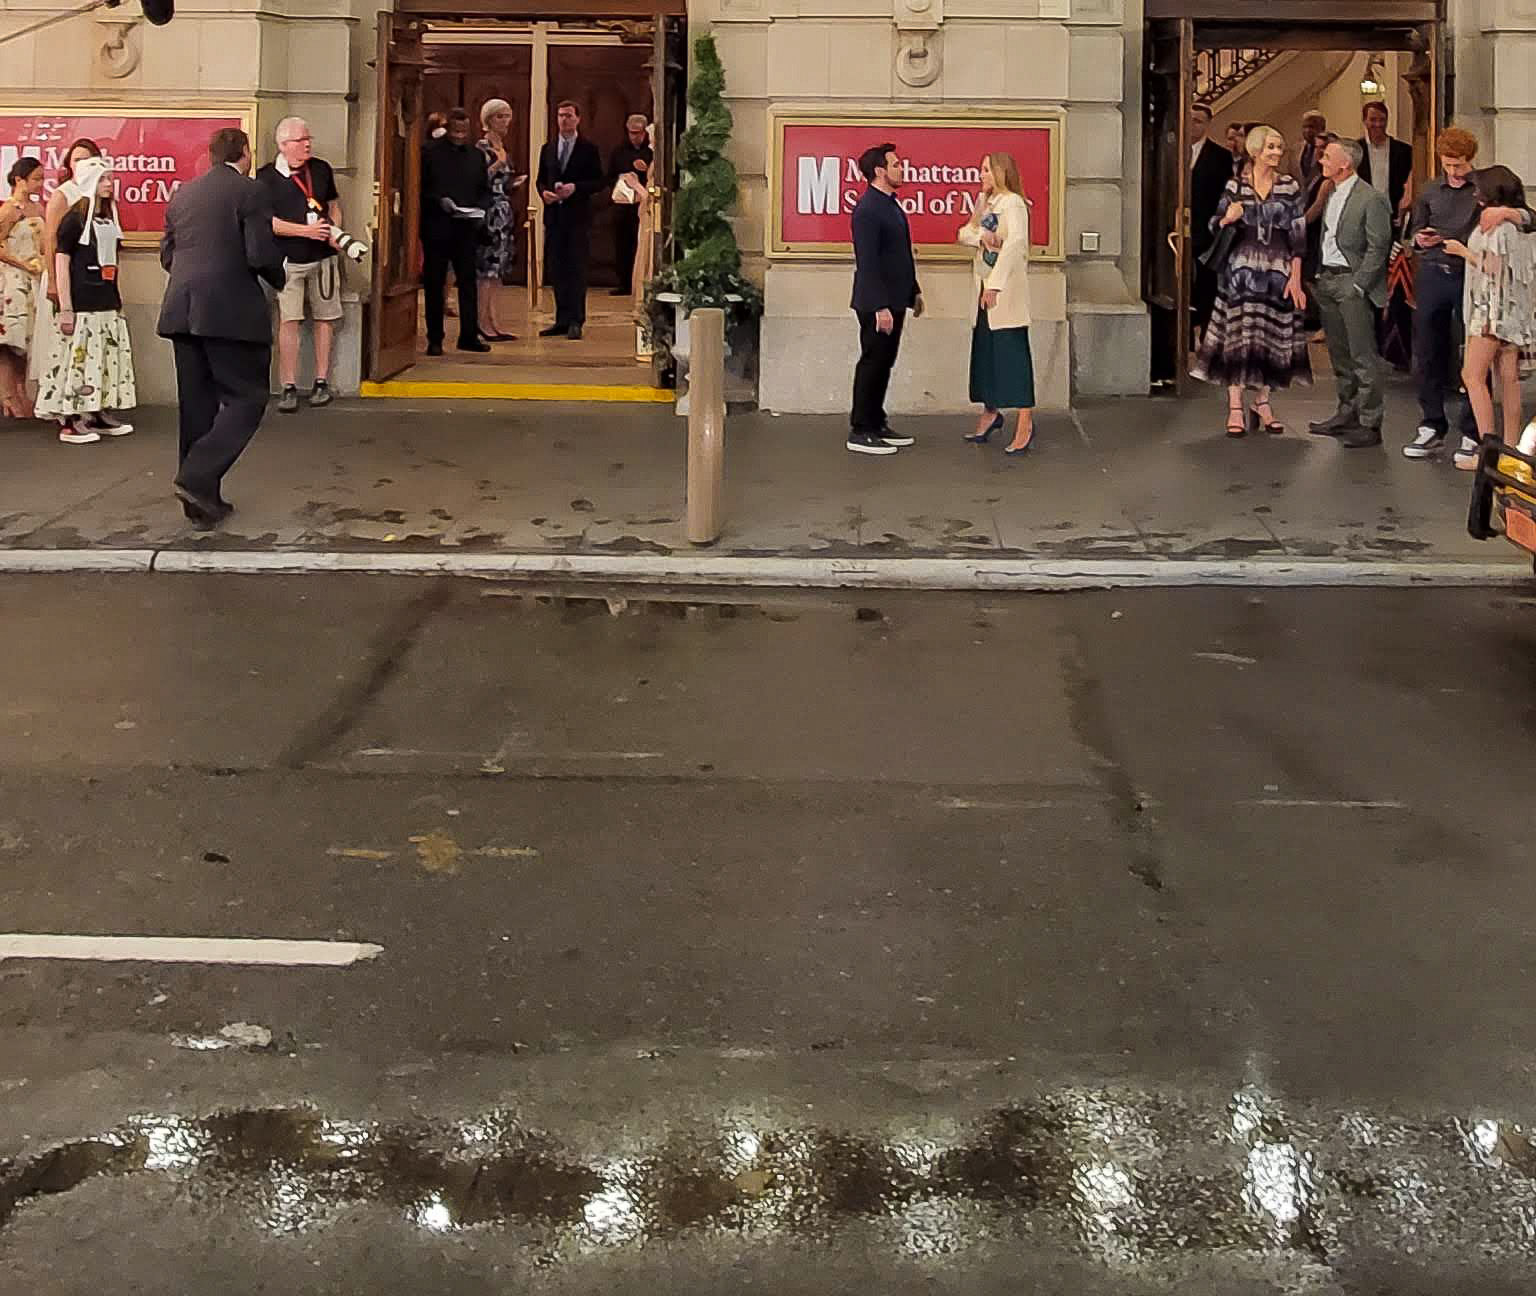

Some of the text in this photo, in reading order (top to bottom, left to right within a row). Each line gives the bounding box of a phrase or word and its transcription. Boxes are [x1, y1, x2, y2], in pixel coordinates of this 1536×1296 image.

[44, 147, 176, 172] Mhattan
[845, 158, 981, 182] Mhattan
[125, 178, 151, 202] of
[798, 156, 841, 215] M
[929, 190, 959, 214] of
